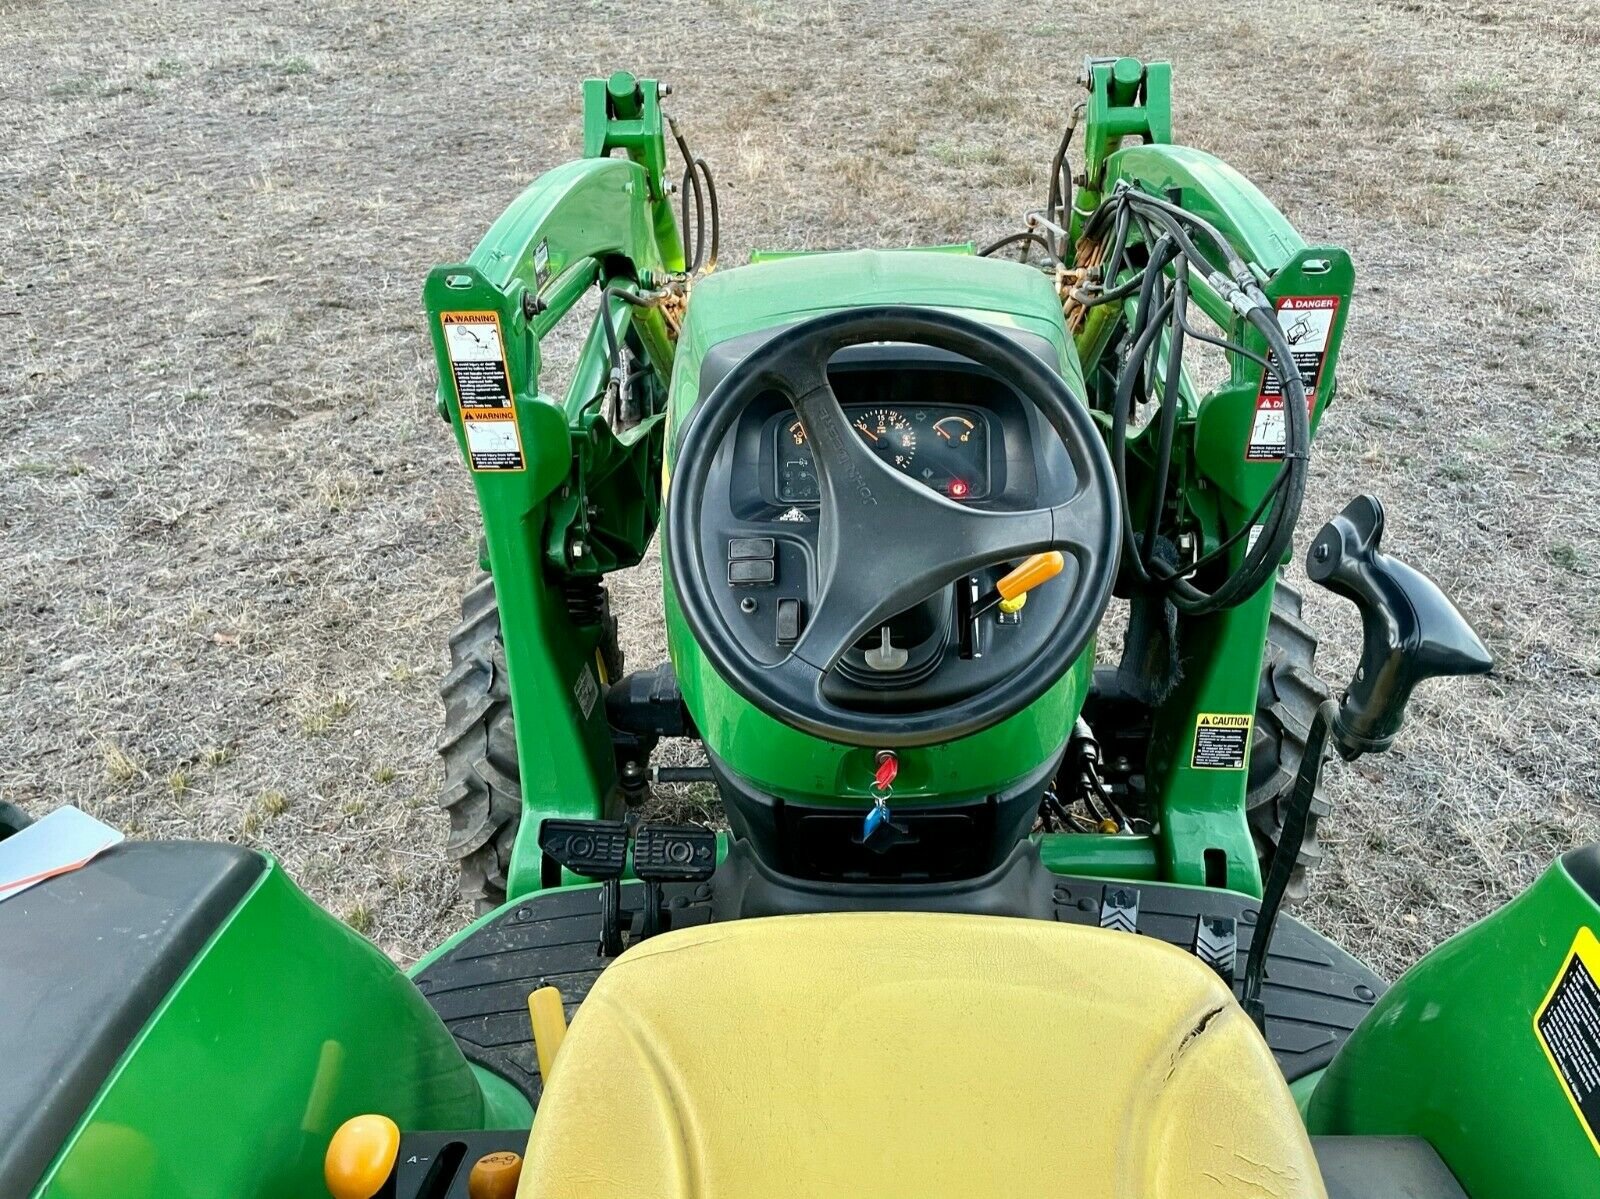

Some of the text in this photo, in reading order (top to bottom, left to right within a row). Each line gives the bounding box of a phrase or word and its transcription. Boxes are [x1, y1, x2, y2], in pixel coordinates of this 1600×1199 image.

[1295, 300, 1334, 308] DANGER
[474, 411, 514, 420] WARNING
[895, 422, 904, 430] 20
[1212, 716, 1250, 726] CAUTION
